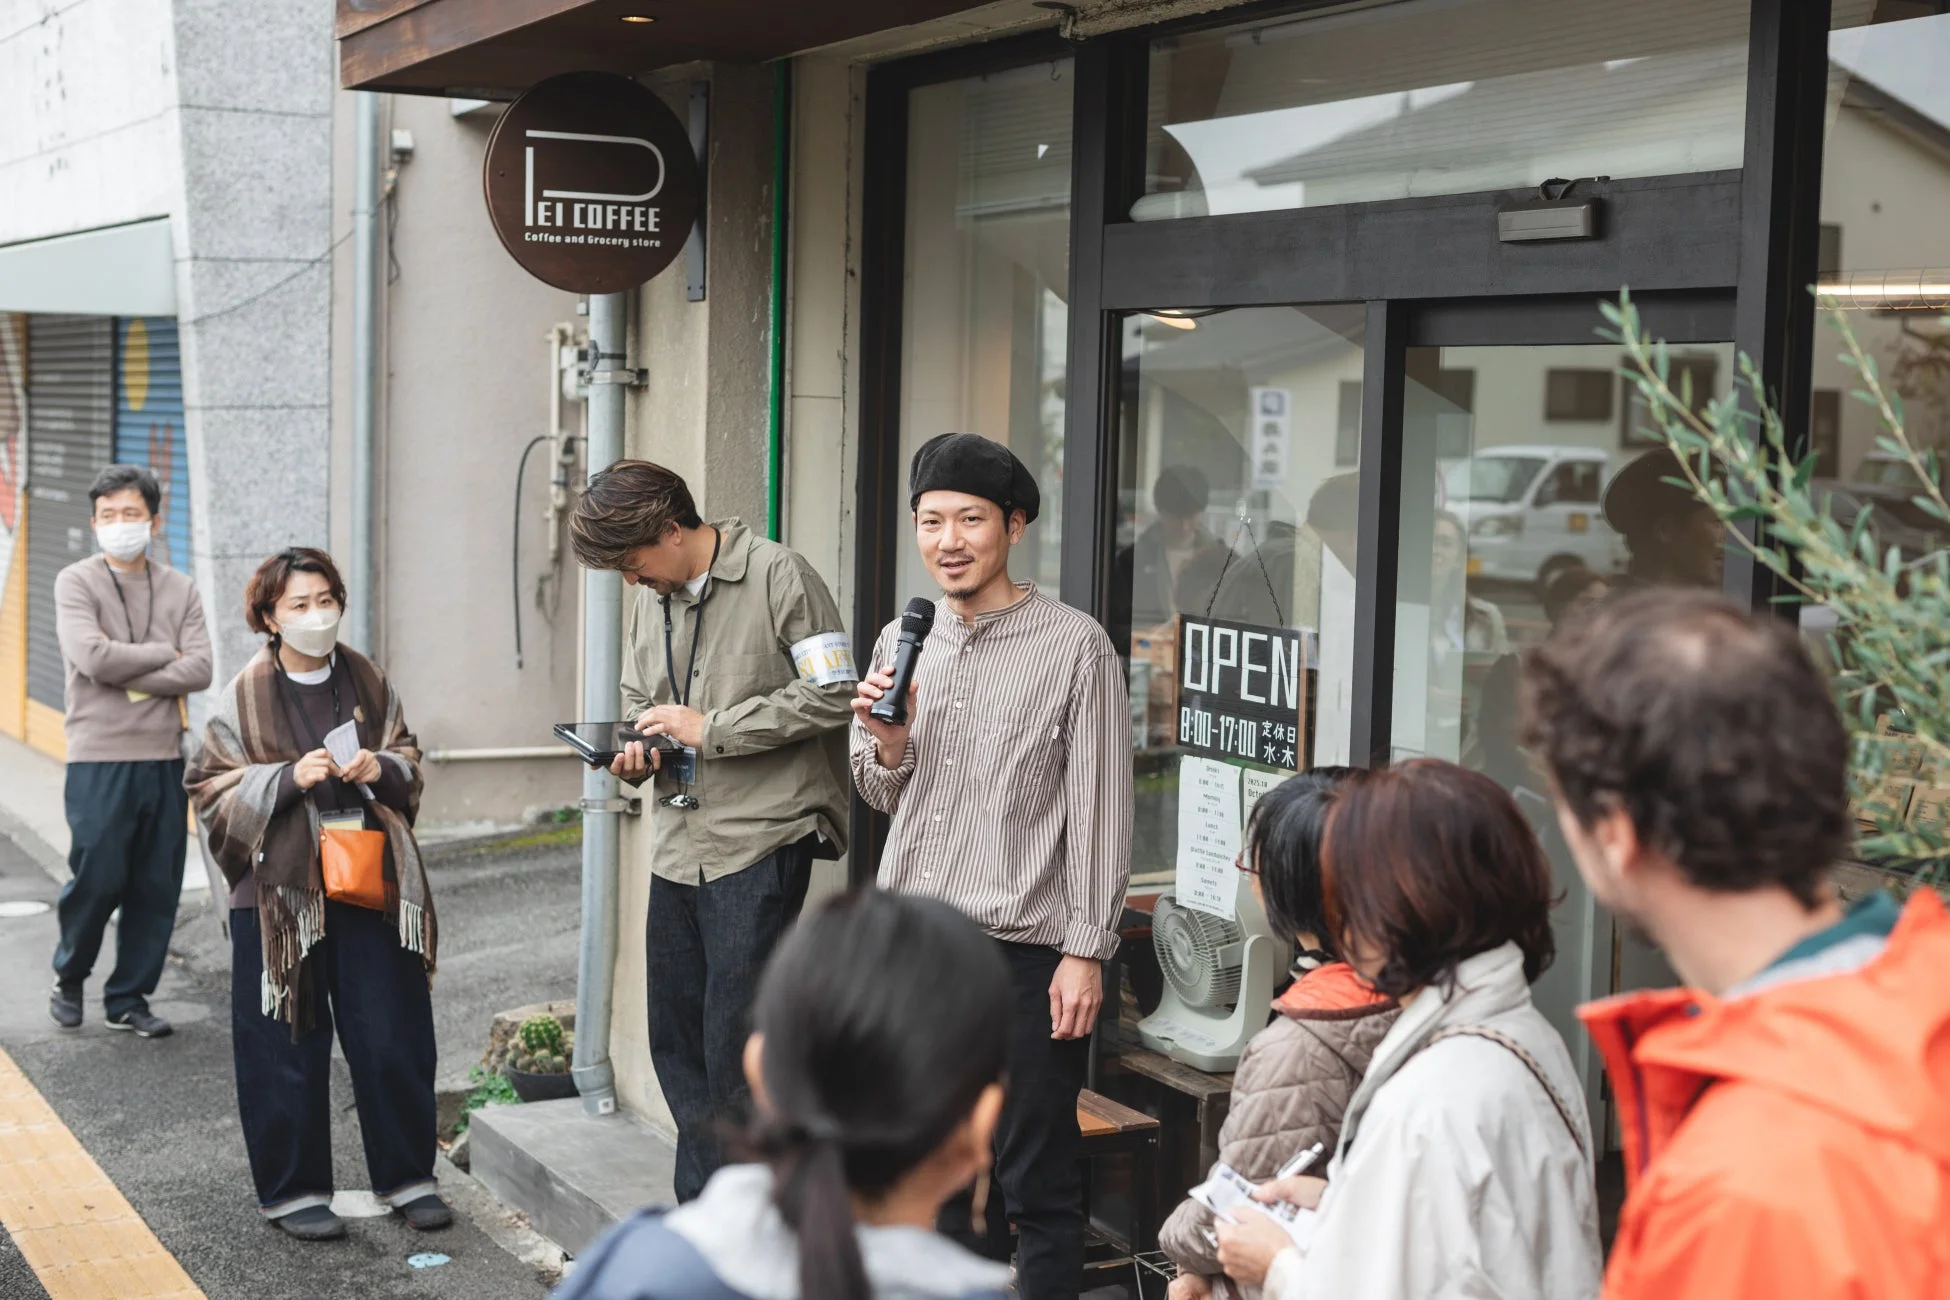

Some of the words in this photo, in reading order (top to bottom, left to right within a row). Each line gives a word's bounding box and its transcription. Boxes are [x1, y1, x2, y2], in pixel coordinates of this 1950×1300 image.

[573, 203, 660, 232] COFFEE
[525, 231, 562, 244] Coffee
[564, 234, 585, 244] and
[587, 235, 630, 248] Grocery
[632, 237, 661, 248] store
[1183, 621, 1299, 710] OPEN
[1180, 706, 1257, 758] 8:00-17:00
[1261, 719, 1296, 744] 定休日
